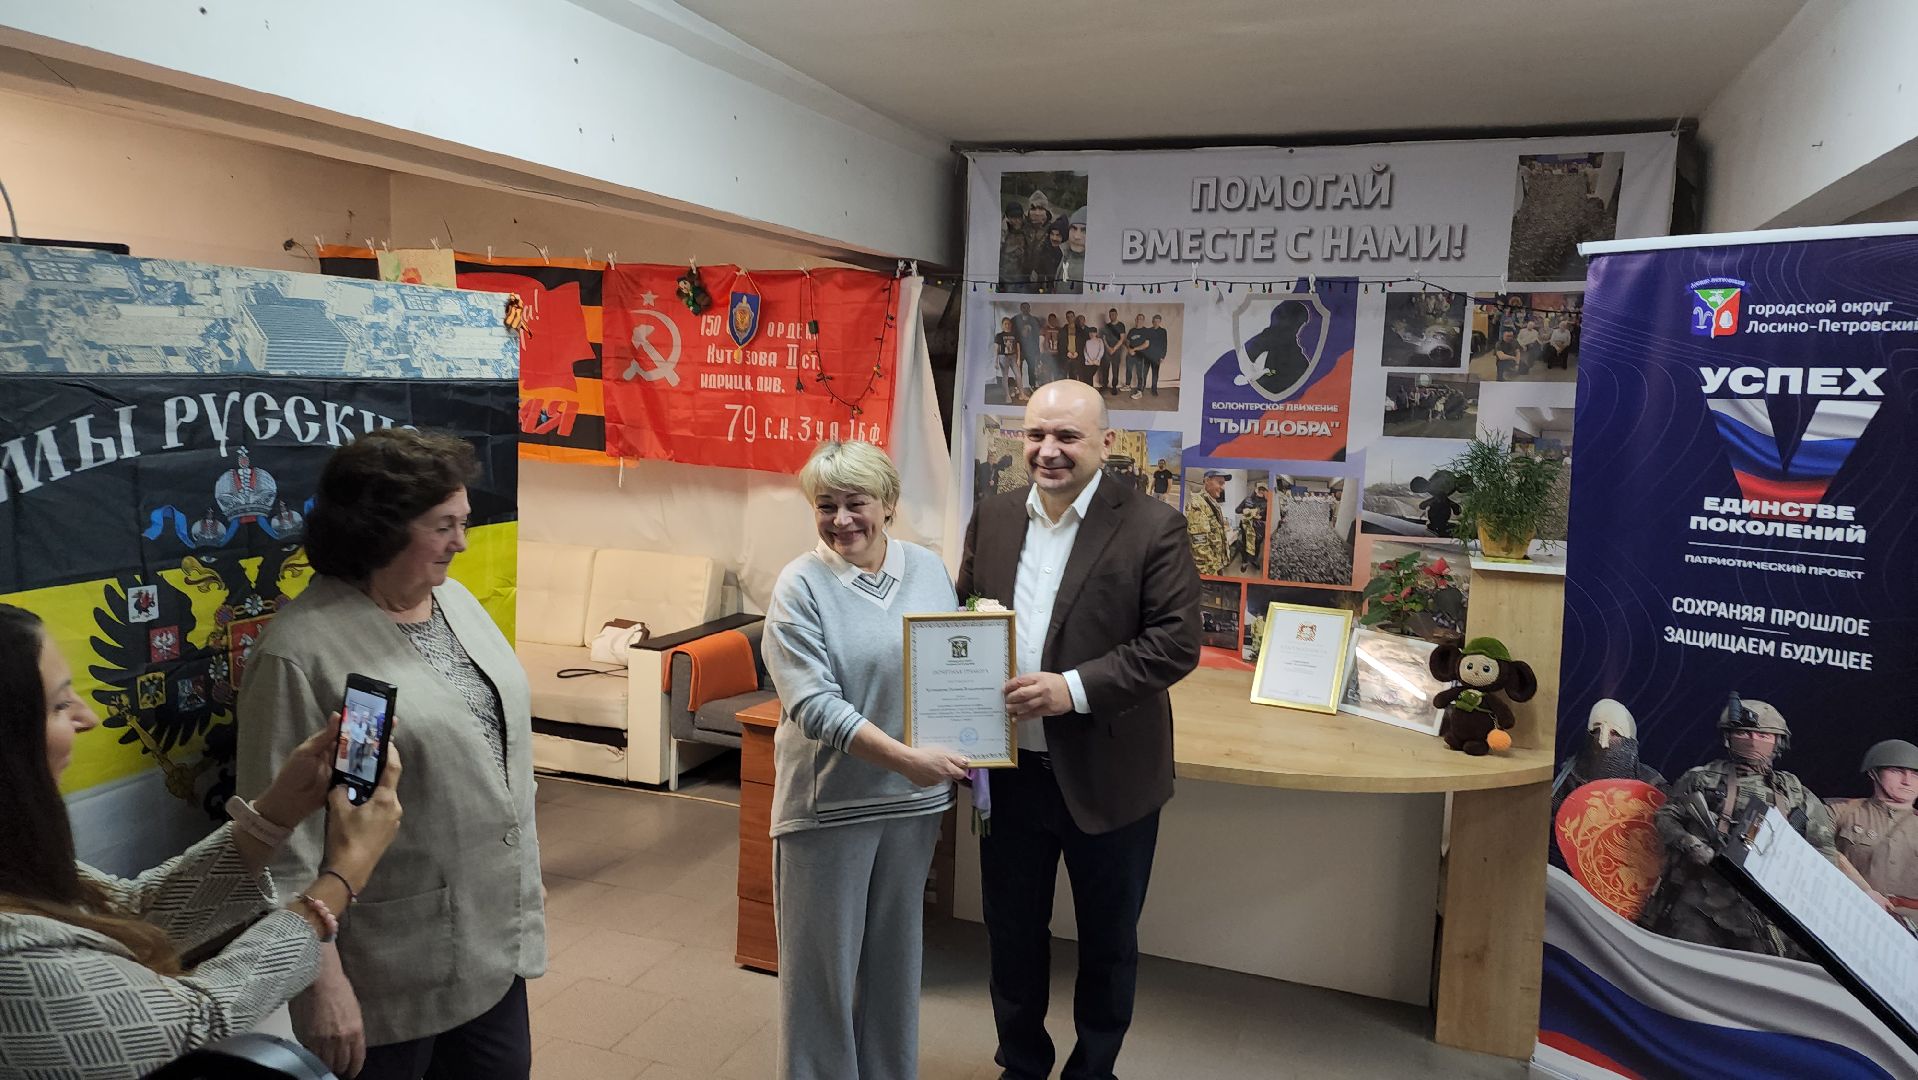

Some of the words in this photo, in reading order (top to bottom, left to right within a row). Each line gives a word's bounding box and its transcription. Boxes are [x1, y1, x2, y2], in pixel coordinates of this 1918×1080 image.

[1191, 163, 1395, 210] ПОМОГАЙ
[1122, 227, 1276, 261] ВМЕСТЕ
[1285, 227, 1311, 260] С
[1322, 224, 1467, 260] НАМИ!
[1748, 300, 1836, 317] городской
[1841, 301, 1893, 316] округ
[700, 315, 722, 336] 150
[767, 321, 819, 340] ОРДЕН
[1699, 366, 1888, 396] УСПЕХ
[1211, 401, 1285, 411] ВОЛОНТЕРСКОЕ
[1286, 403, 1339, 413] ДВИЖЕНИЕ
[724, 404, 756, 443] 79
[1209, 417, 1260, 434] "ТЫЛ
[1263, 420, 1340, 437] ДОБРА"
[0, 404, 141, 502] МЫ
[162, 391, 420, 457] РУССК
[1703, 496, 1856, 521] ЕДИНСТВЕ
[1689, 515, 1867, 544] ПОКОЛЕНИЙ
[1684, 554, 1807, 574] ПАТРИОТИЧЕСКИЙ
[1808, 566, 1866, 580] ПРОЕКТ
[1671, 596, 1766, 624] СОХРАНЯЯ
[1770, 608, 1871, 637] ПРОШЛОЕ
[1663, 626, 1776, 657] ЗАЩИЩАЕМ
[1780, 642, 1874, 671] БУДУЩЕЕ
